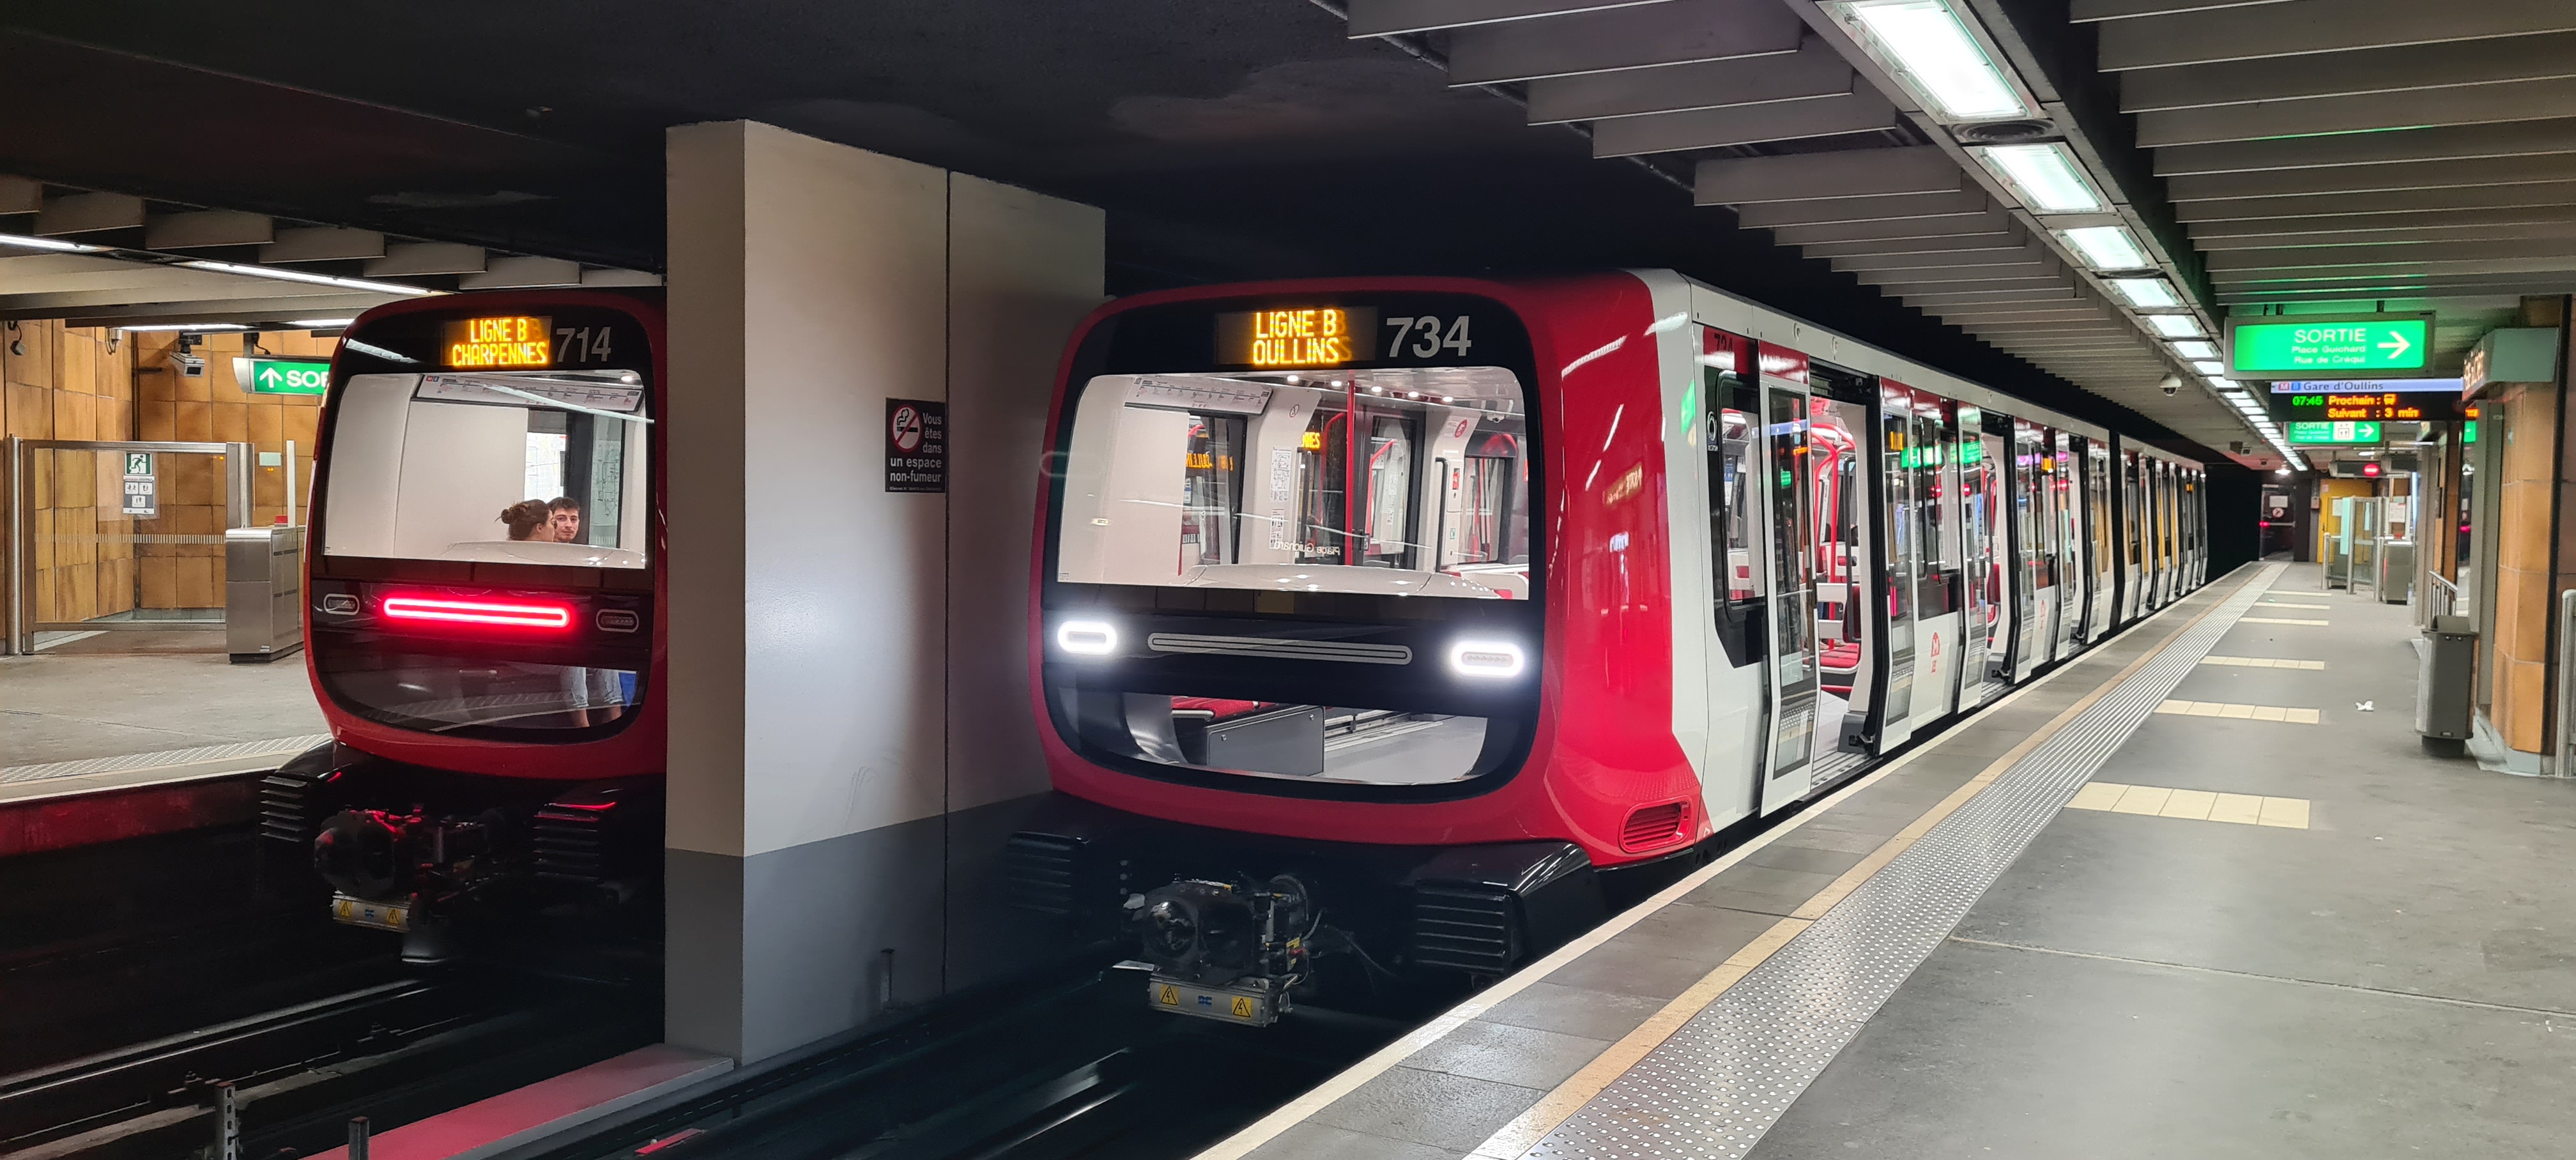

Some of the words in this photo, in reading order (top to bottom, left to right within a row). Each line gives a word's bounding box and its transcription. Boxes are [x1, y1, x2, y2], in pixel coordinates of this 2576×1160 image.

[1256, 310, 1315, 339] LIGNE
[1323, 309, 1337, 337] B
[470, 319, 512, 342] LIGNE
[517, 319, 527, 341] B
[2294, 328, 2366, 343] SORTIE
[1386, 316, 1472, 358] 734
[556, 326, 611, 362] 714
[2322, 345, 2366, 353] Guichard
[452, 342, 547, 366] CHARPENNES
[1253, 337, 1339, 364] OULLINS
[2333, 355, 2365, 364] Créqui
[2303, 382, 2329, 390] Gare
[2333, 381, 2384, 390] d'Oullins
[2292, 395, 2324, 406] 07:45
[2328, 395, 2375, 405] Prochain
[923, 413, 942, 425] Vous
[2327, 408, 2367, 418] Suivant
[2384, 408, 2393, 418] 3
[2398, 408, 2419, 418] min
[924, 427, 942, 439] êtes
[923, 442, 942, 454] dans
[890, 457, 903, 467] un
[907, 458, 942, 469] espace
[890, 469, 941, 482] non-fumeur
